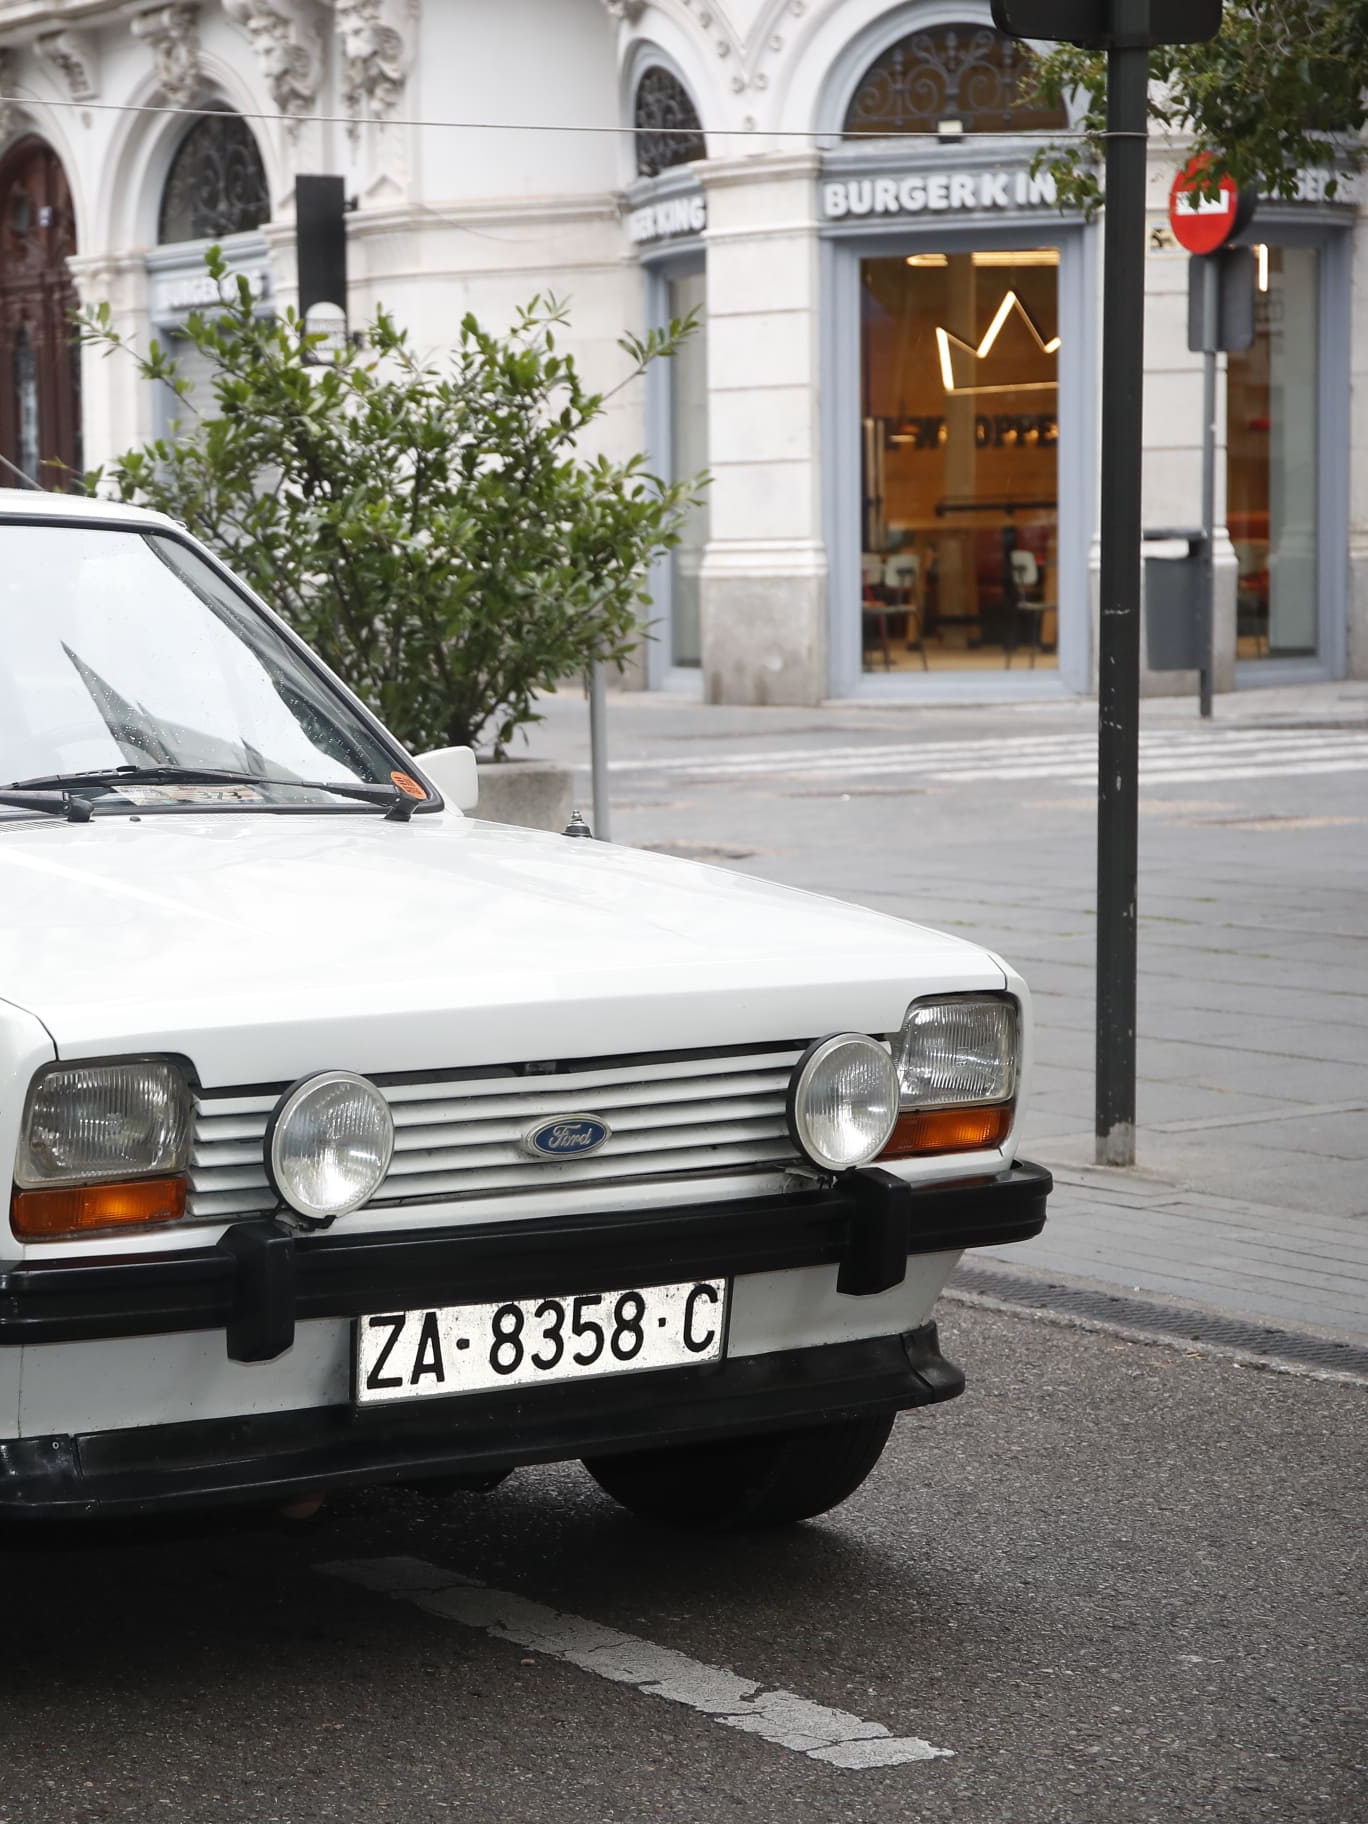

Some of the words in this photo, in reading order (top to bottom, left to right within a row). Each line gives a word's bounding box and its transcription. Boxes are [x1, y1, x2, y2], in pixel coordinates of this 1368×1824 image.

[823, 174, 977, 217] BURGER
[982, 171, 1077, 207] KIN
[548, 1124, 593, 1149] Ford
